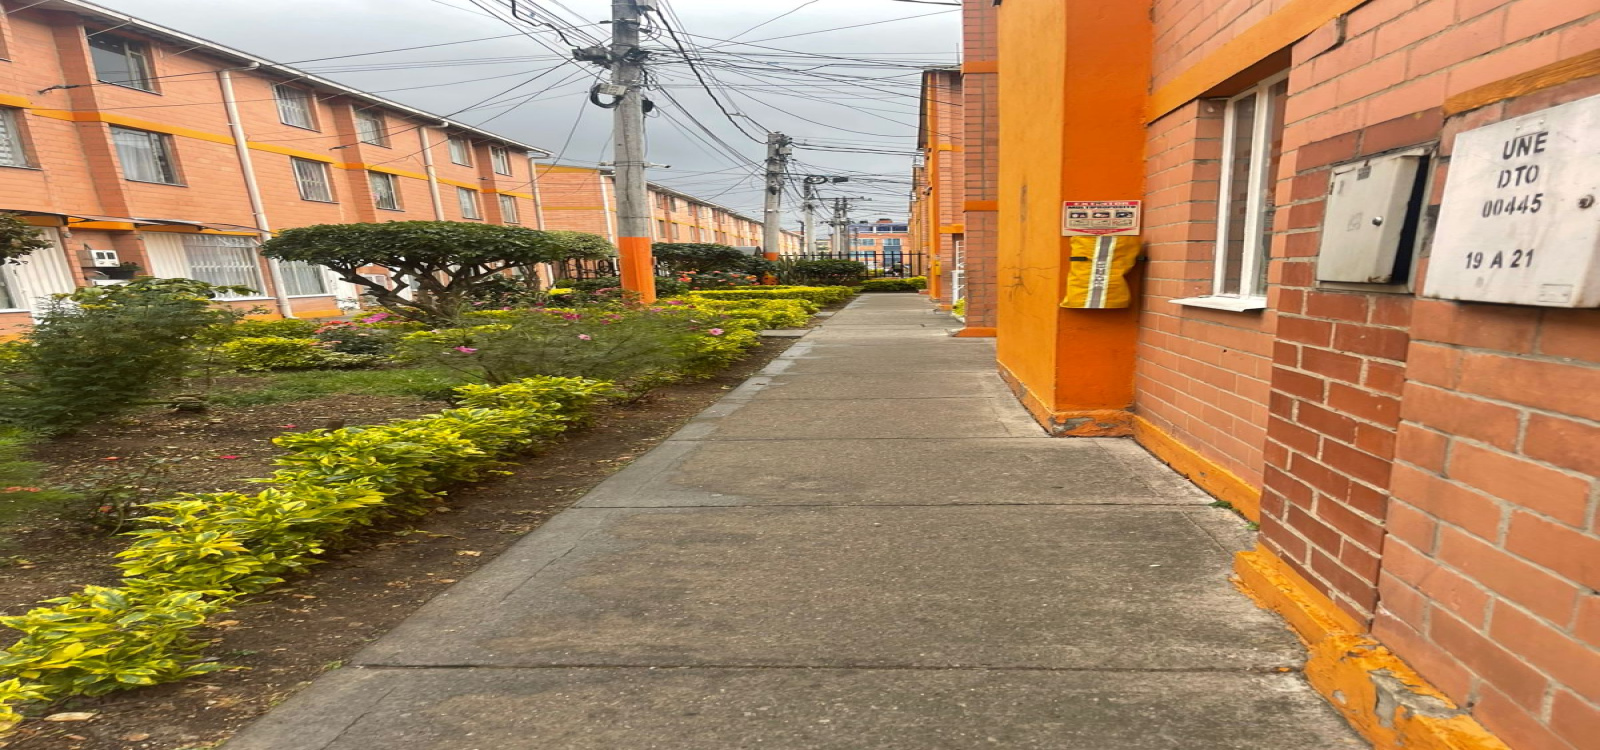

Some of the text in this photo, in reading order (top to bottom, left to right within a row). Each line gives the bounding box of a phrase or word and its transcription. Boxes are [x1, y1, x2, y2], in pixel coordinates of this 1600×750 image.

[1502, 131, 1549, 160] UNE
[1496, 164, 1540, 189] DTO
[1482, 193, 1544, 219] 00445
[1465, 249, 1535, 269] 19 A 21
